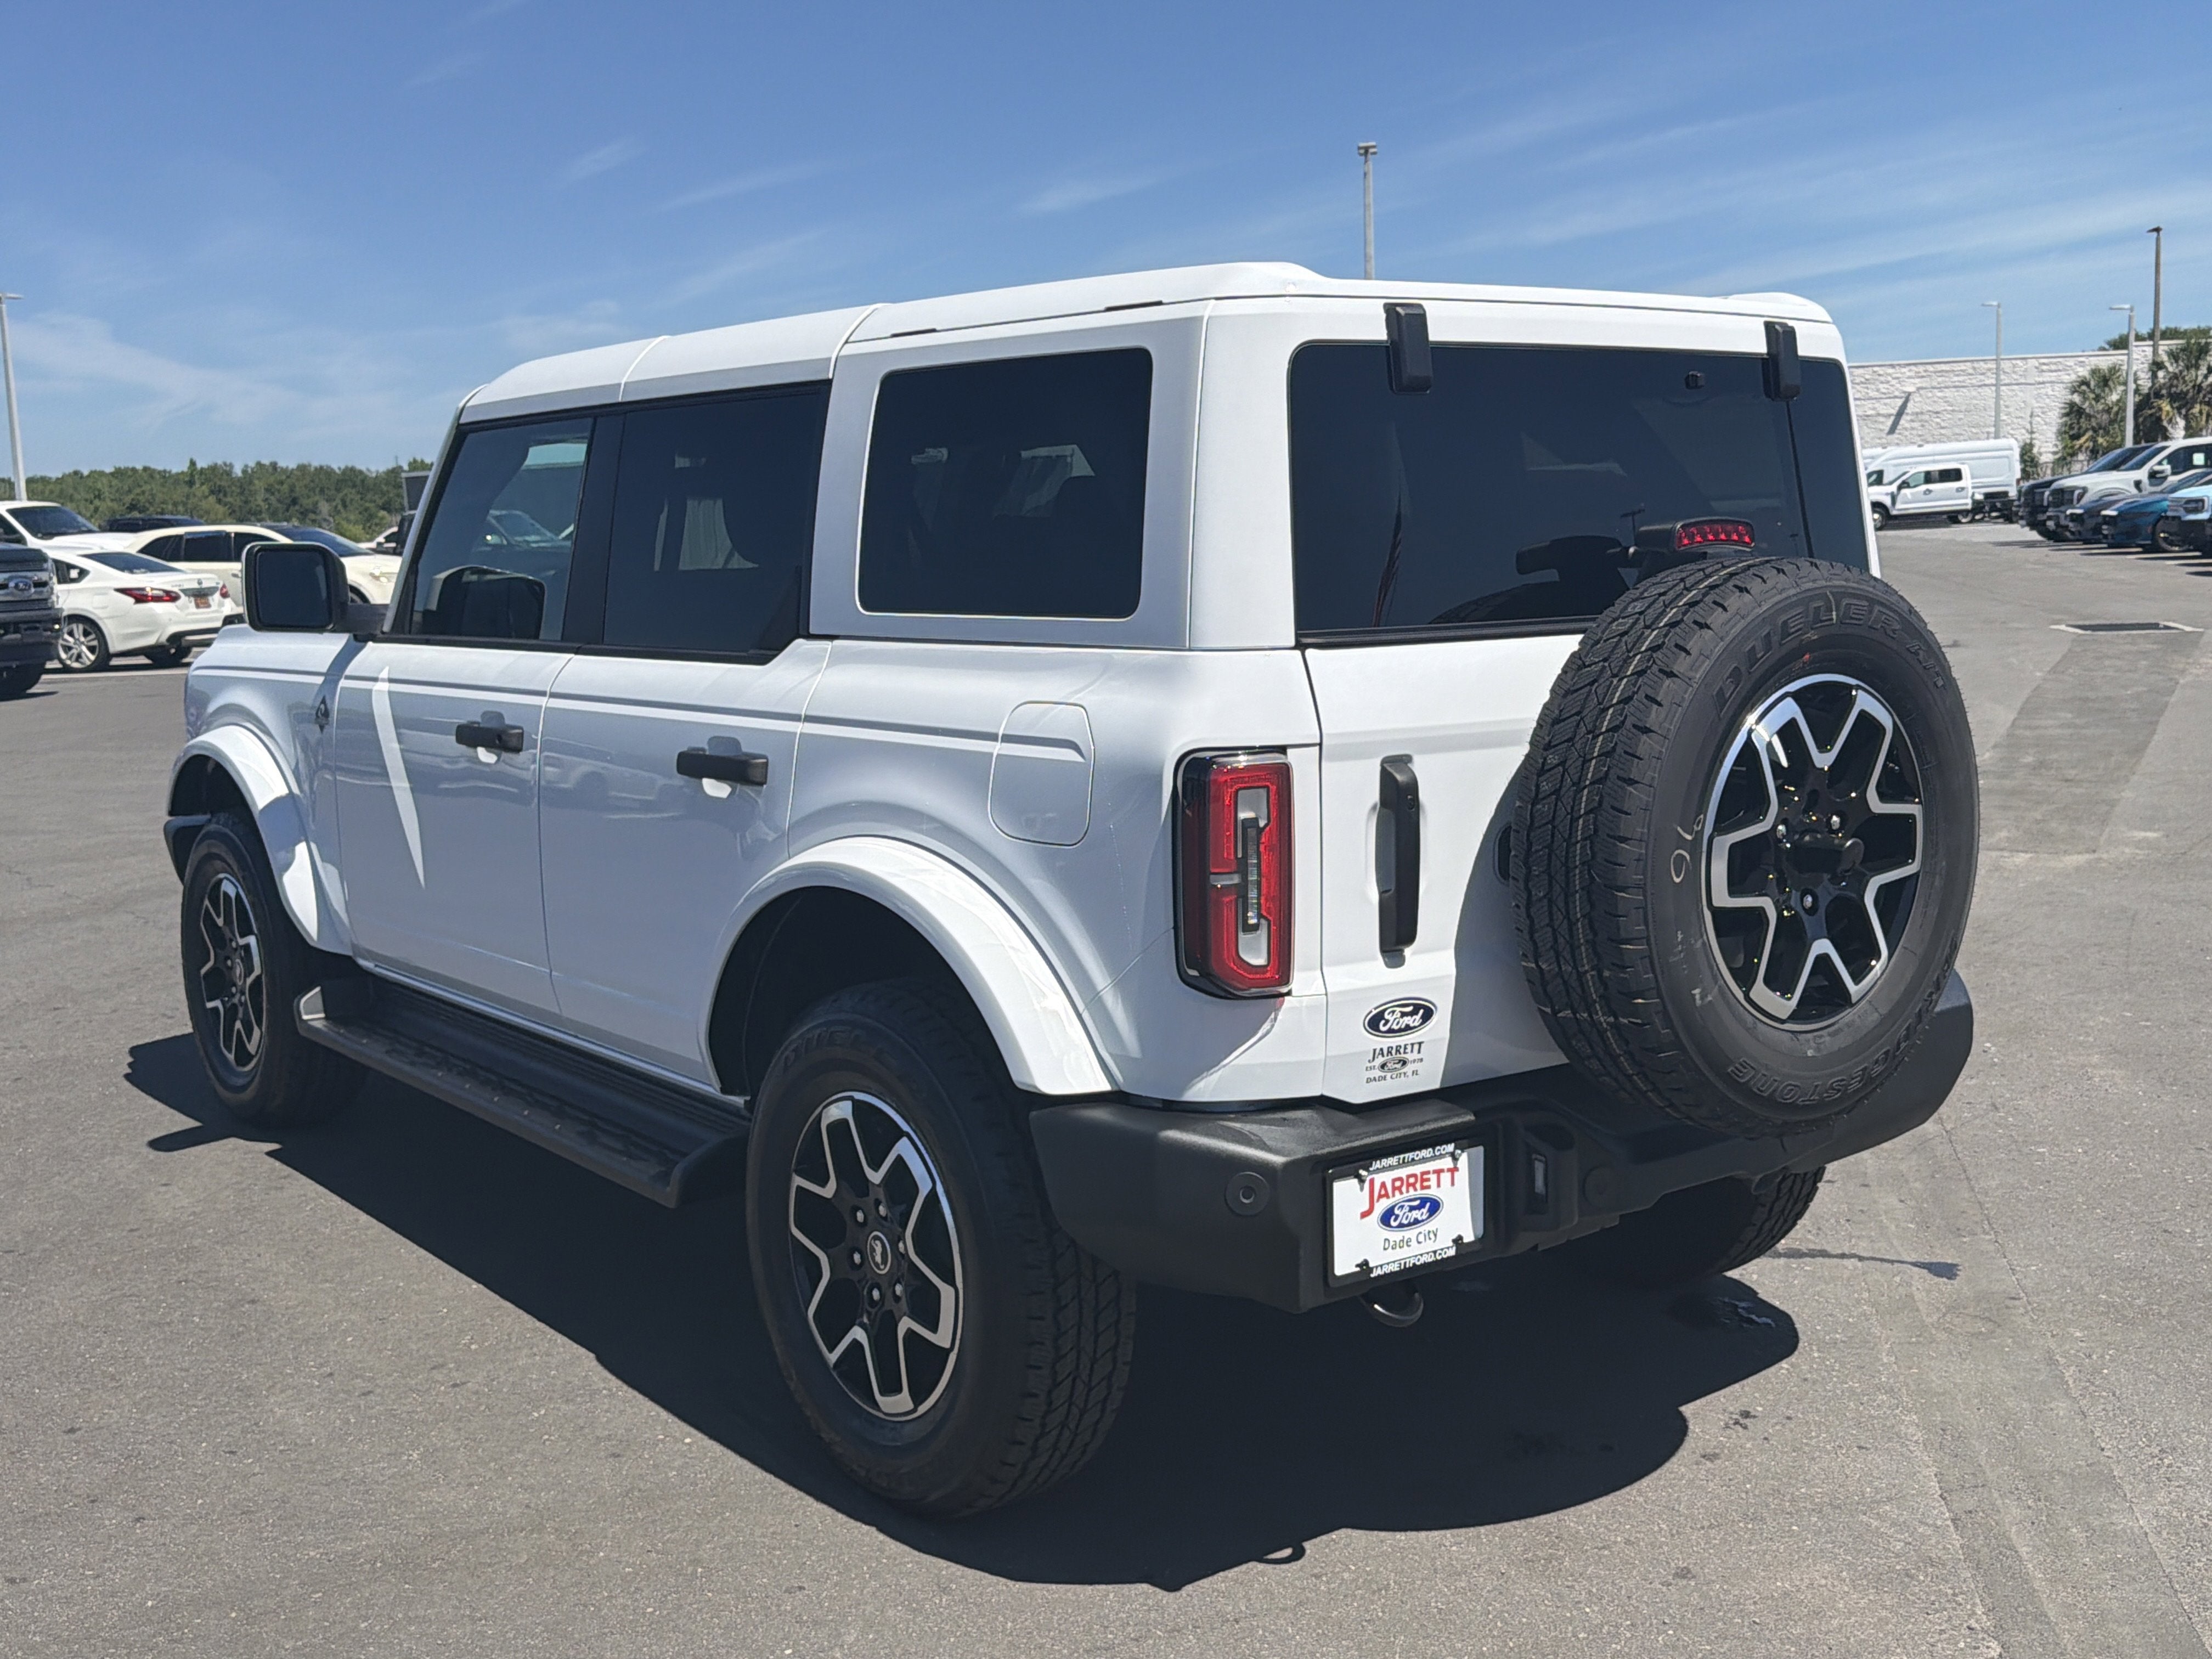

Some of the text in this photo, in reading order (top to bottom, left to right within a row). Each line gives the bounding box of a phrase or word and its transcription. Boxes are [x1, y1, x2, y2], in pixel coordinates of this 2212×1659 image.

[1379, 1006, 1425, 1031] Ford
[1368, 1041, 1425, 1064] JARRETT
[1365, 1075, 1387, 1084] DADE
[1390, 1071, 1409, 1080] CITY,
[1369, 1143, 1455, 1171] JARRETTFORD.COM
[1359, 1166, 1459, 1220] JARRETT
[1390, 1199, 1430, 1227] Ford
[1383, 1227, 1438, 1251] Dade City
[1370, 1246, 1456, 1277] JARRETTFORD.COM
